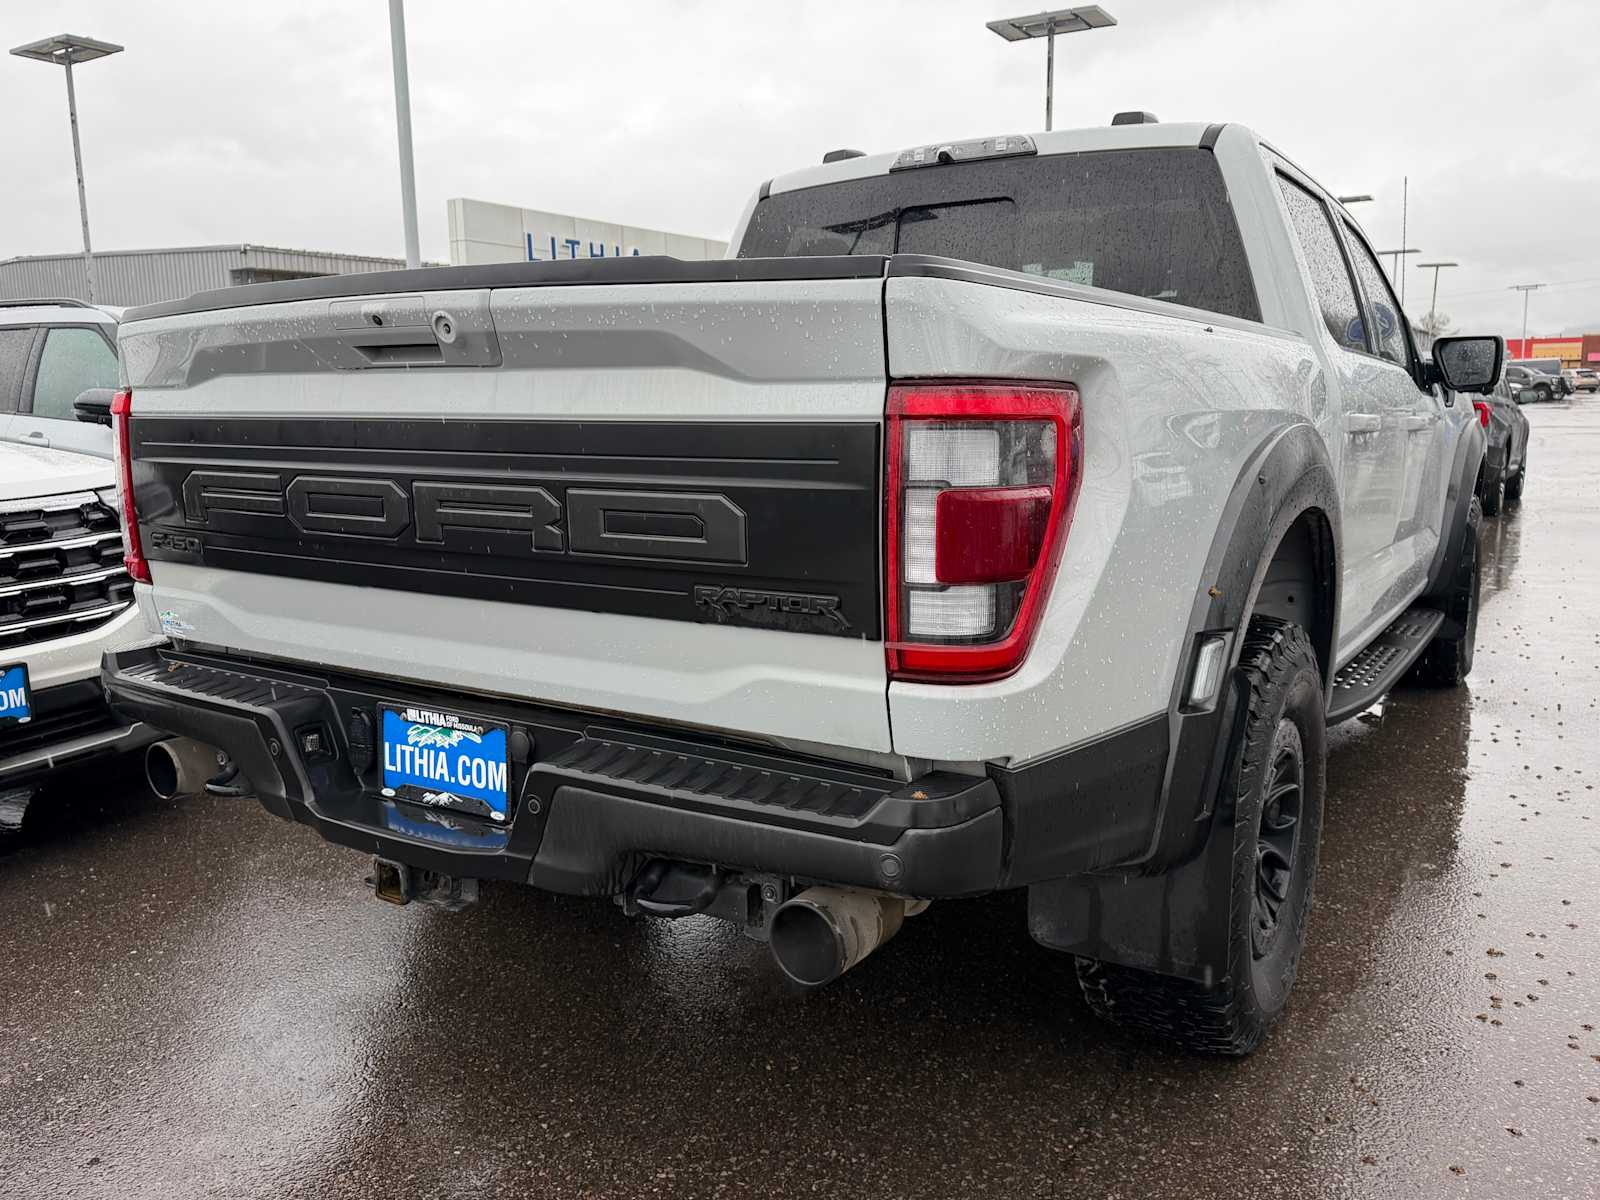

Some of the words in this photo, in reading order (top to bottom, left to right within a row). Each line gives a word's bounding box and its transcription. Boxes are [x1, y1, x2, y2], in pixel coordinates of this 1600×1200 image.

[183, 469, 749, 568] FORD
[694, 584, 851, 631] RAPTOR
[416, 709, 447, 727] LITHIA
[384, 742, 507, 793] LITHIA.COM
